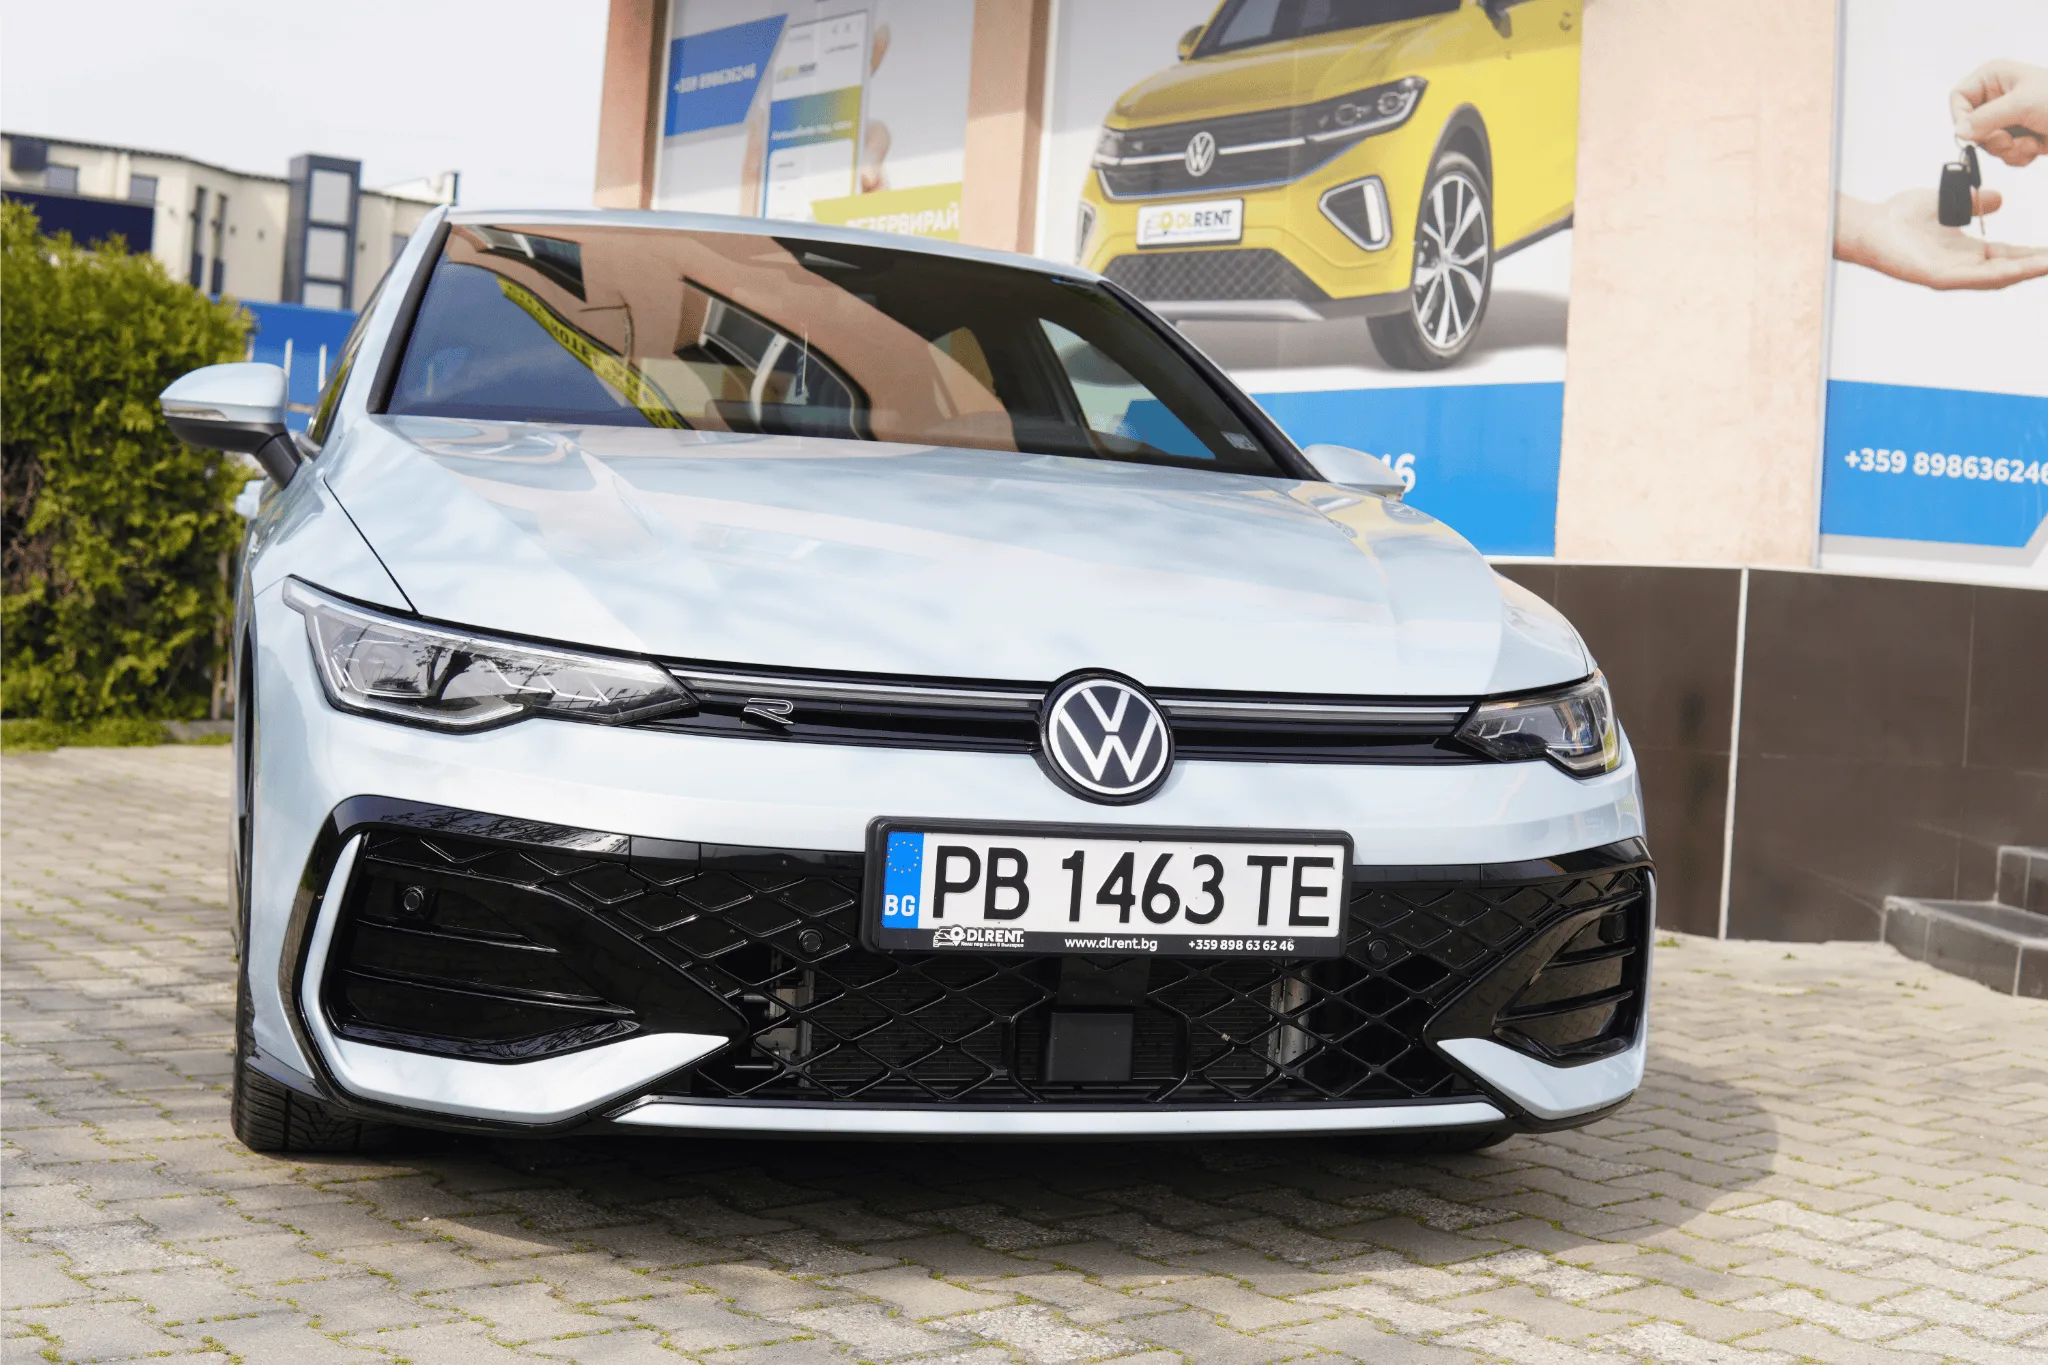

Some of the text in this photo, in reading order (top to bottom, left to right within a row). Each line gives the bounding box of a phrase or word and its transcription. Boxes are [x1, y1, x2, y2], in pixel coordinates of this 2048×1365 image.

[1844, 447, 1907, 474] +359
[883, 845, 1335, 927] BG PB 1463 TE
[1064, 937, 1158, 952] www.dlrent.bg
[1188, 940, 1295, 952] +359 898 63 62 46
